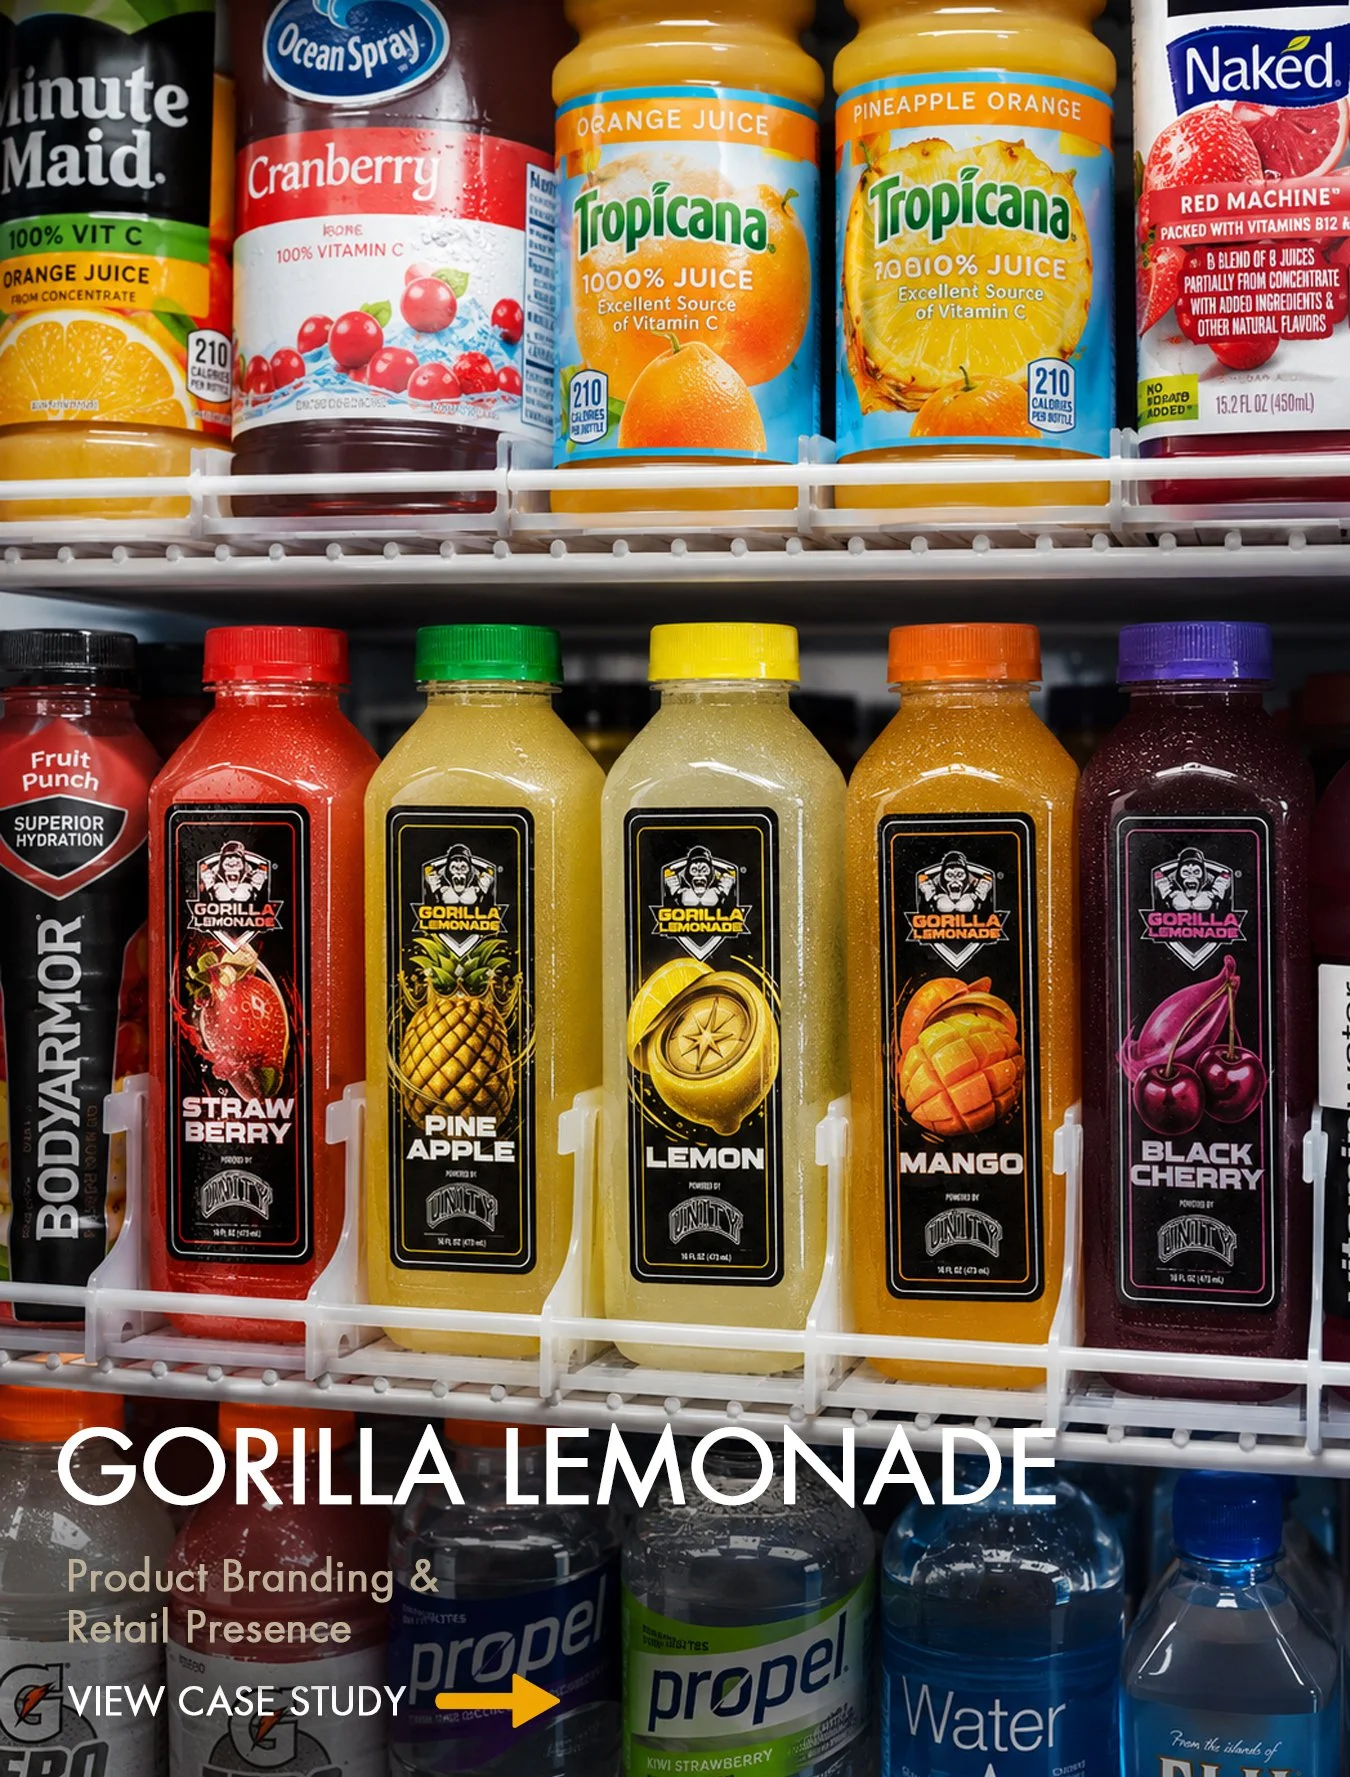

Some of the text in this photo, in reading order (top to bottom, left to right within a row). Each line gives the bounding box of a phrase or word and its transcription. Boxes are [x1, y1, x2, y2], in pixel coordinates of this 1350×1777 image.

[277, 22, 420, 79] Ocean Spray
[1186, 40, 1333, 95] Naked
[853, 91, 1082, 123] PINEAPPLE ORANGE
[577, 108, 770, 138] ORANGE JUICE
[248, 142, 442, 201] Cranberry
[869, 166, 1071, 249] Tropicana
[1181, 194, 1219, 214] RED
[573, 181, 769, 257] Tropicana
[1160, 223, 1207, 240] PACKED
[1211, 220, 1244, 236] WITH
[1248, 217, 1311, 234] VITAMINS
[1315, 217, 1338, 231] B12
[9, 224, 143, 250] 100% VIT C
[277, 243, 404, 263] 100% VITAMIN C
[1218, 250, 1251, 269] BLEND
[1253, 250, 1266, 268] OF
[1280, 248, 1315, 267] JUICES
[3, 264, 150, 288] ORANGE JUICE
[987, 254, 1067, 280] JUICE
[673, 267, 753, 291] JUICE
[1184, 273, 1235, 294] PARTIALLY
[1237, 272, 1267, 290] FROM
[11, 290, 136, 305] FROM CONCENTRATE
[898, 283, 1044, 302] Excellent Source
[1190, 291, 1335, 316] WITH ADDED INGREDIENTS &
[598, 295, 737, 314] Excellent Source
[916, 303, 1027, 320] of Vitamin C
[613, 315, 719, 332] of Vitamin C
[1197, 314, 1327, 337] OTHER NATURAL FLAVORS
[195, 338, 229, 367] 210
[573, 378, 602, 408] 210
[1035, 367, 1070, 398] 210
[1147, 383, 1163, 396] NO
[1216, 395, 1238, 415] 15.2
[1240, 394, 1252, 413] FL
[1255, 394, 1268, 413] OZ
[31, 749, 91, 769] Fruit
[22, 771, 100, 792] Punch
[14, 815, 104, 831] SUPERIOR
[16, 832, 104, 847] HYDRATION
[194, 903, 275, 916] GORILLA
[419, 906, 500, 919] GORILLA
[658, 908, 744, 921] GORILLA
[912, 914, 1001, 928] GORILLA
[1148, 912, 1239, 927] GORILLA
[194, 916, 275, 928] LEMONADE
[659, 922, 744, 933] LEMONADE
[1148, 927, 1239, 939] LEMONADE
[913, 928, 1001, 940] LEMONADE
[36, 917, 83, 1240] BODYARMOR
[182, 1097, 295, 1119] STRAW
[185, 1121, 292, 1144] BERRY
[425, 1115, 497, 1137] PINE
[406, 1139, 515, 1162] APPLE
[646, 1146, 765, 1170] LEMON
[1141, 1140, 1253, 1165] BLACK
[900, 1152, 1024, 1175] MANGO
[1131, 1164, 1265, 1190] CHERRY
[647, 1611, 847, 1732] propel
[902, 1675, 1066, 1752] Water
[1170, 1730, 1283, 1763] From the islands of
[647, 1748, 773, 1773] KIWI STRAWBERRY
